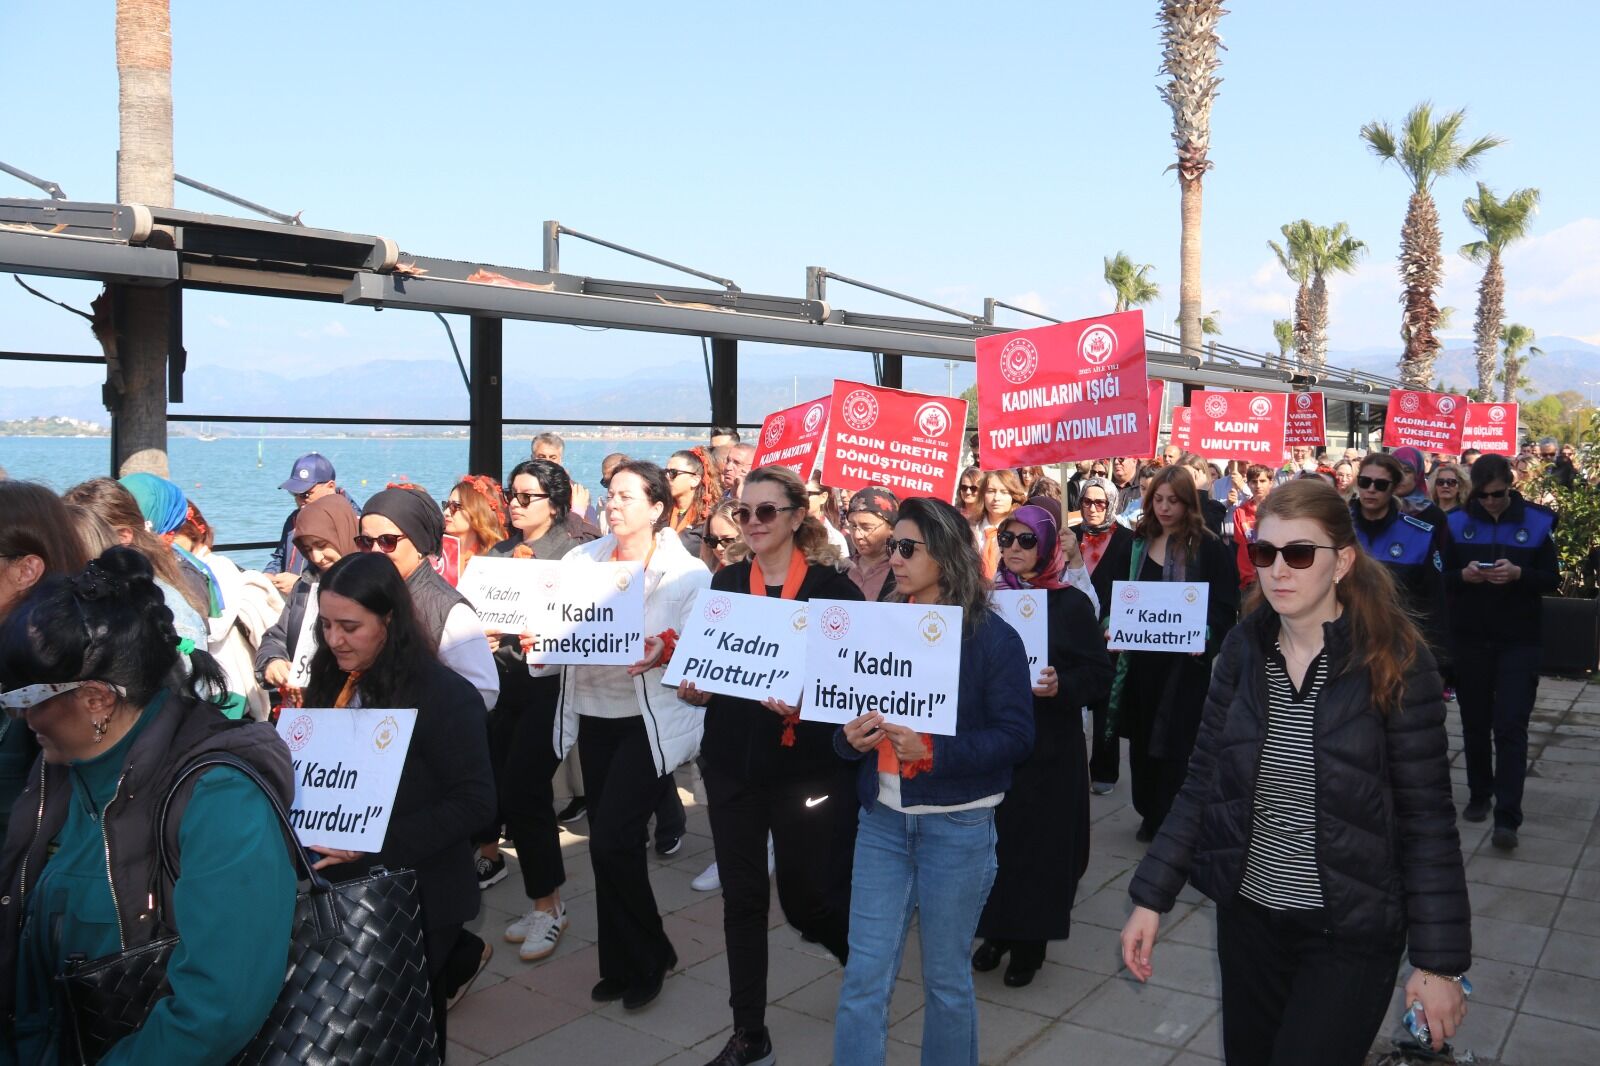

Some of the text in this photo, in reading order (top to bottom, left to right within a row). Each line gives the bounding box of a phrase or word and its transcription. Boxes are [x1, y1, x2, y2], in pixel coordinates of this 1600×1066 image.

[1002, 372, 1120, 412] KADINLARIN IŞIĞI
[990, 423, 1051, 449] TOPLUMU
[1055, 413, 1137, 441] AYDINLATIR
[1214, 421, 1258, 433] KADIN
[1393, 416, 1457, 430] KADINLARLA
[1397, 427, 1450, 440] YÜKSELEN
[759, 441, 813, 466] KADIN HAYATIN
[836, 432, 885, 450] KADIN
[890, 441, 948, 462] ÜRETİR
[1201, 438, 1271, 452] UMUTTUR
[1400, 437, 1444, 449] TÜRKİYE
[836, 449, 944, 478] DÖNÜŞTÜRÜR
[842, 464, 933, 492] İYİLEŞTİRİR
[485, 586, 520, 601] Kadın
[562, 602, 614, 622] Kadın
[1138, 609, 1182, 623] Kadın
[716, 632, 780, 658] Kadın
[683, 657, 789, 689] Pilottur!”
[853, 650, 912, 677] Kadın
[302, 762, 358, 789] Kadın
